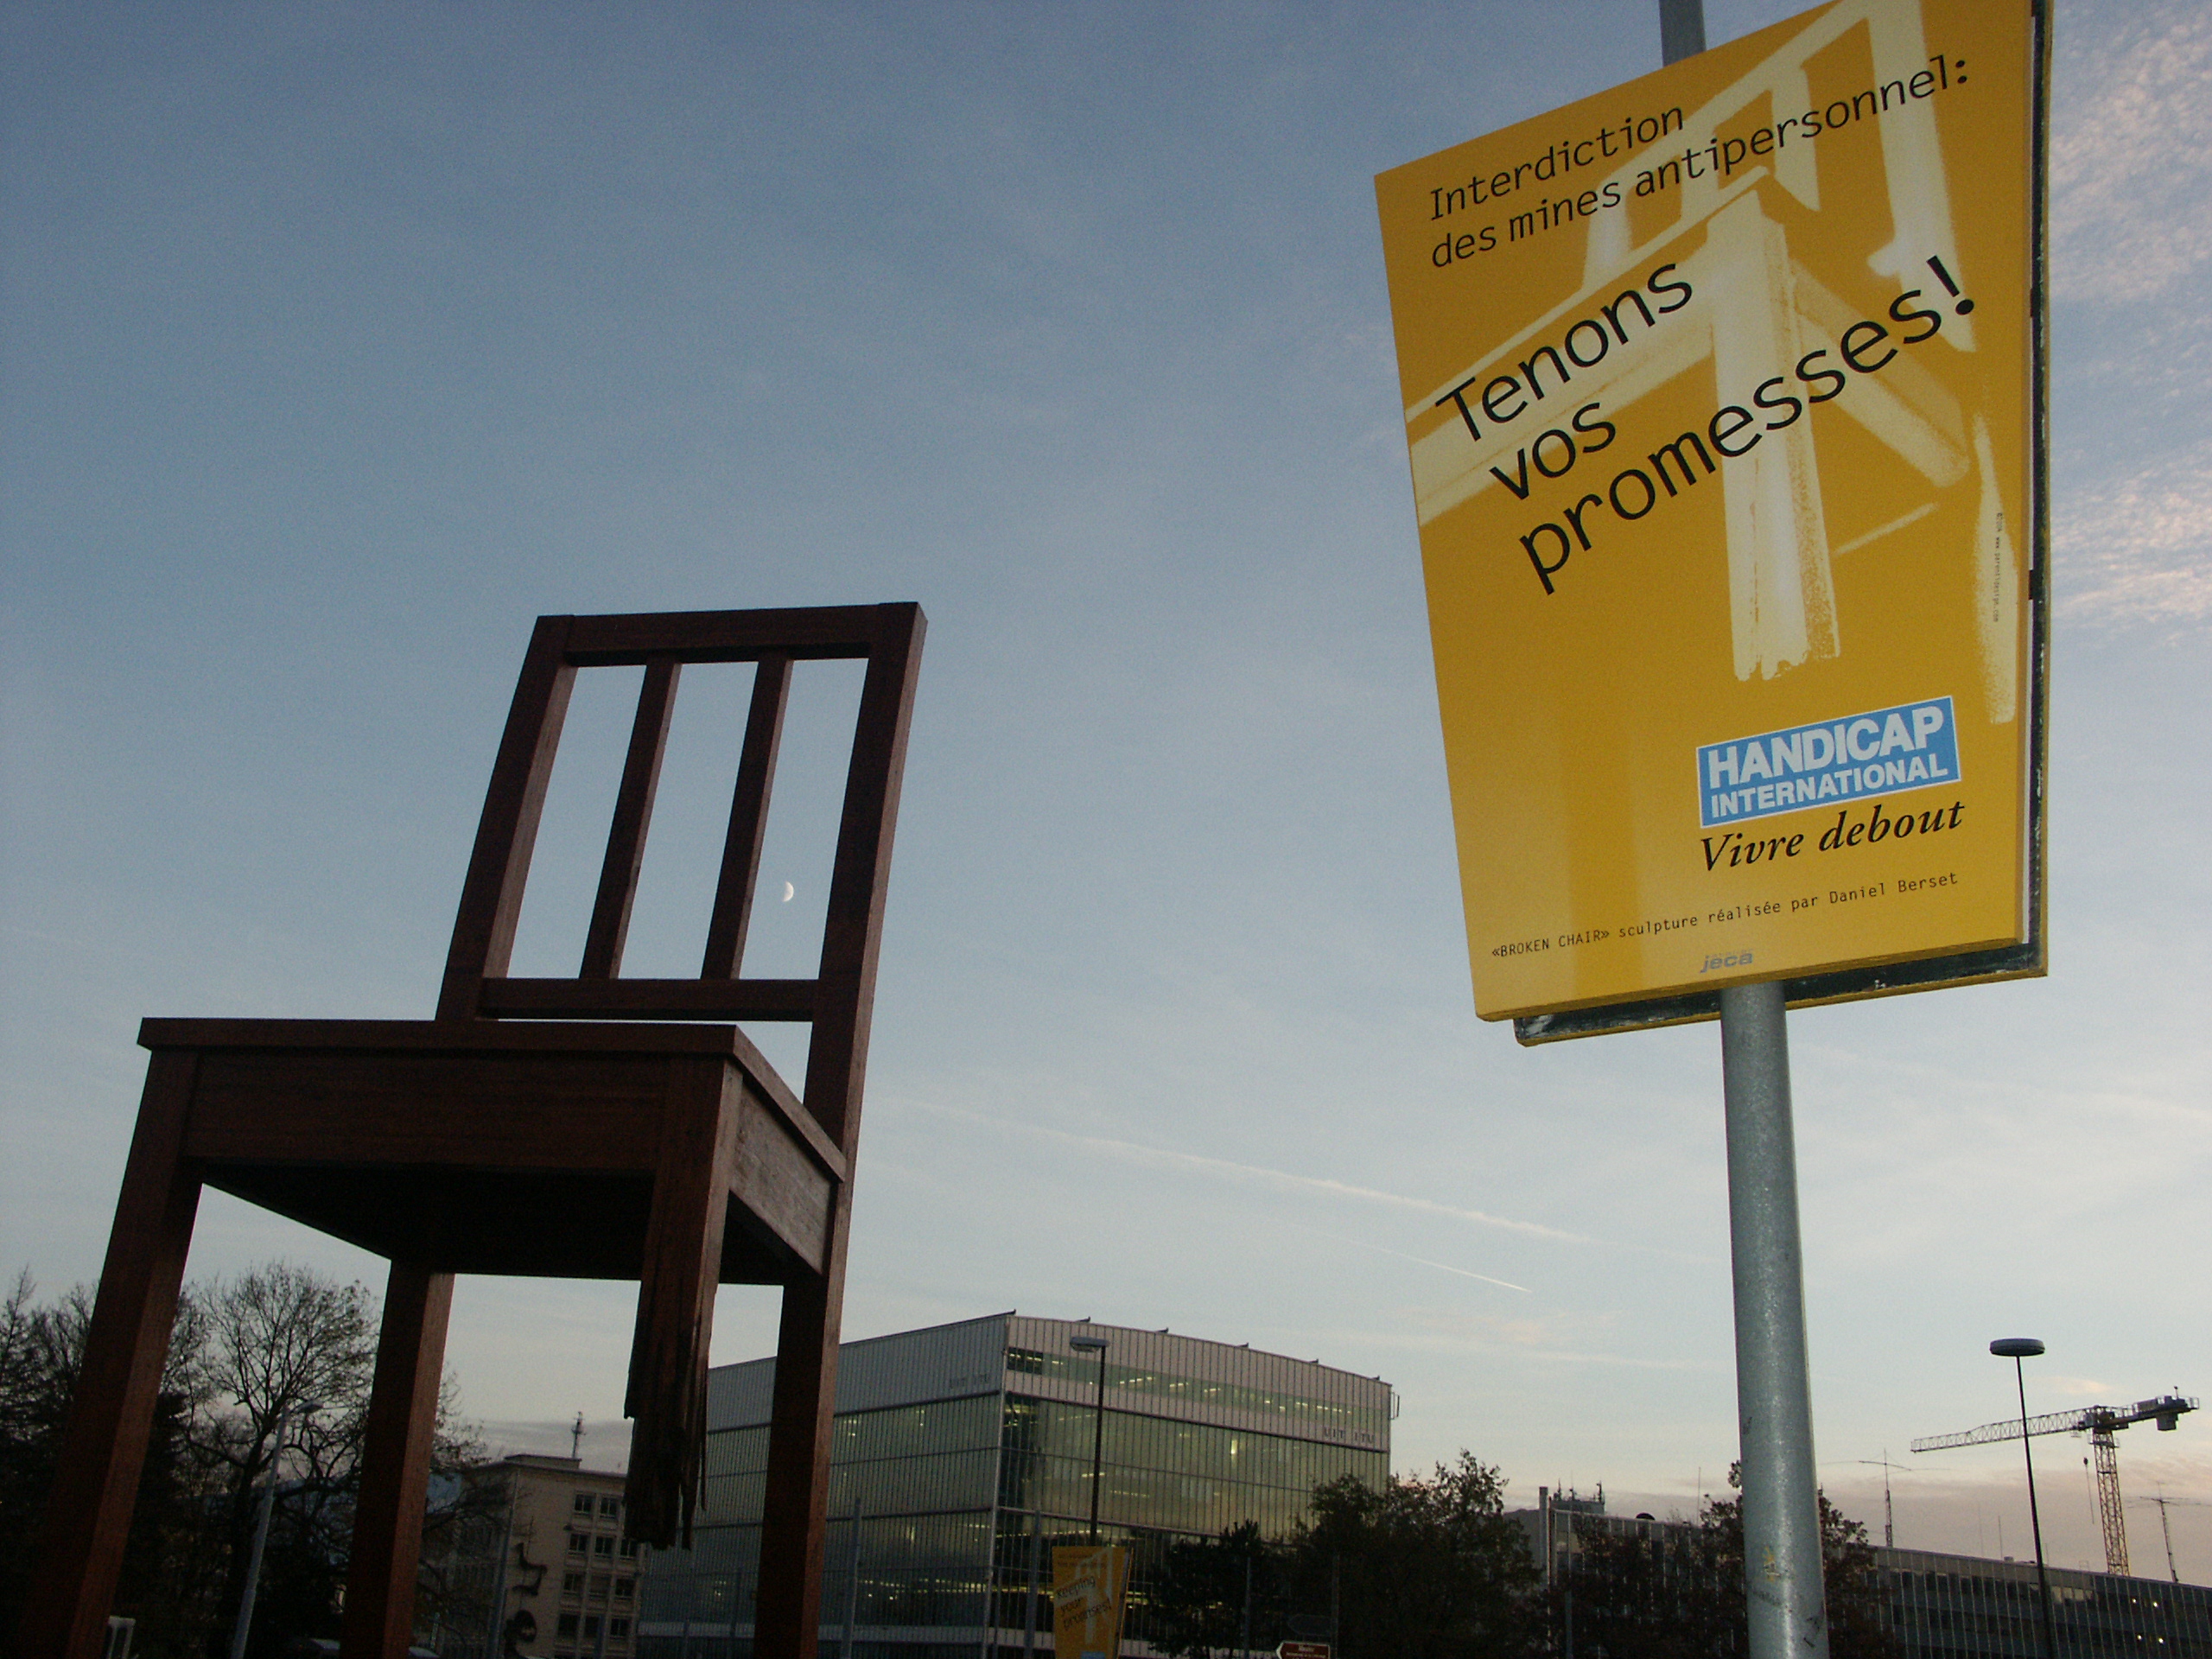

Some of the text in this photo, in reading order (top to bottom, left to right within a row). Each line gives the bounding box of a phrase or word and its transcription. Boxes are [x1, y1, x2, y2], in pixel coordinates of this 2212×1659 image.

[1430, 106, 1684, 221] Interdiction
[1431, 54, 1968, 268] des mines antipersonnel:
[1434, 263, 1694, 442] Tenons
[1489, 402, 1617, 501] vos
[1518, 255, 1975, 596] promesses!
[1707, 706, 1943, 790] HANDICAP
[1711, 753, 1948, 818] INTERNATIONAL
[1700, 800, 1965, 872] Vivre debout
[1618, 916, 1698, 938] sculpture
[1708, 900, 1781, 923] réalisée
[1791, 895, 1818, 912] par
[1829, 882, 1885, 904] Daniel
[1897, 872, 1958, 893] Berset
[1700, 955, 1753, 973] jeca
